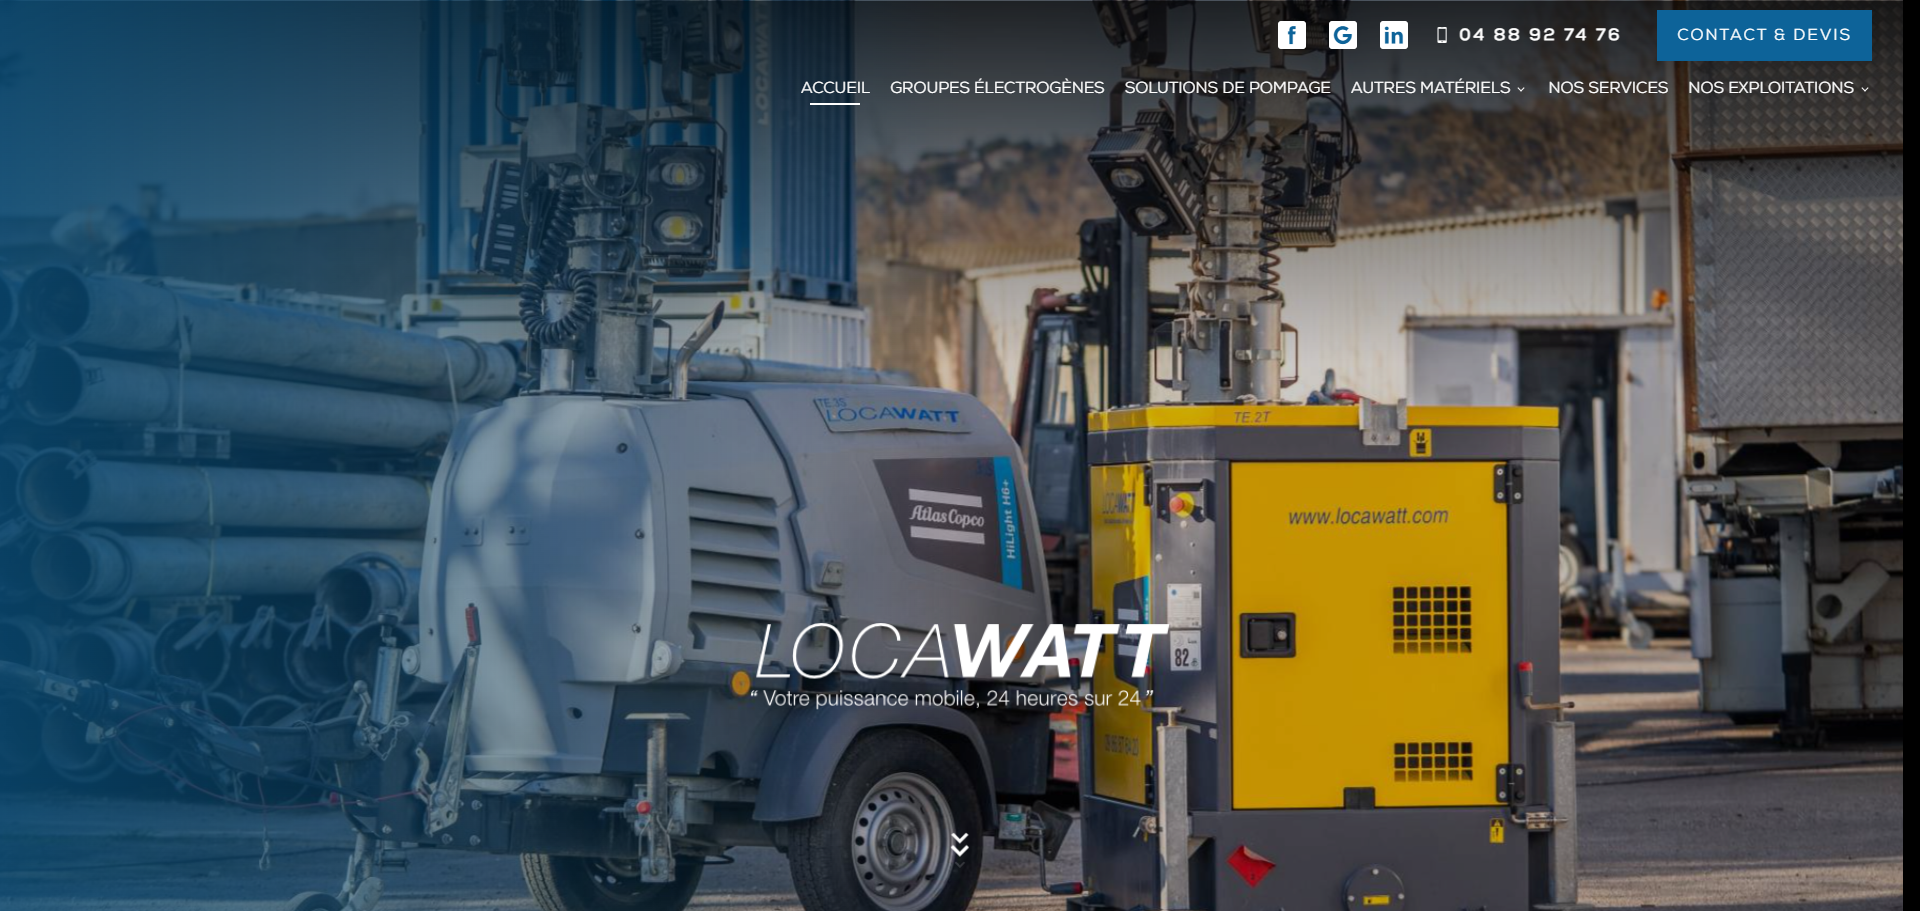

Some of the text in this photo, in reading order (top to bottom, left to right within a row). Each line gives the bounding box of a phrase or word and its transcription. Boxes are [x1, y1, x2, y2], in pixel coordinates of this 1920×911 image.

[826, 407, 959, 422] LOCAWATT
[909, 505, 984, 529] Atlas Copco
[1001, 479, 1016, 559] HiLight H6+
[1288, 508, 1449, 525] www.locawatt.com
[1175, 648, 1189, 667] 82
